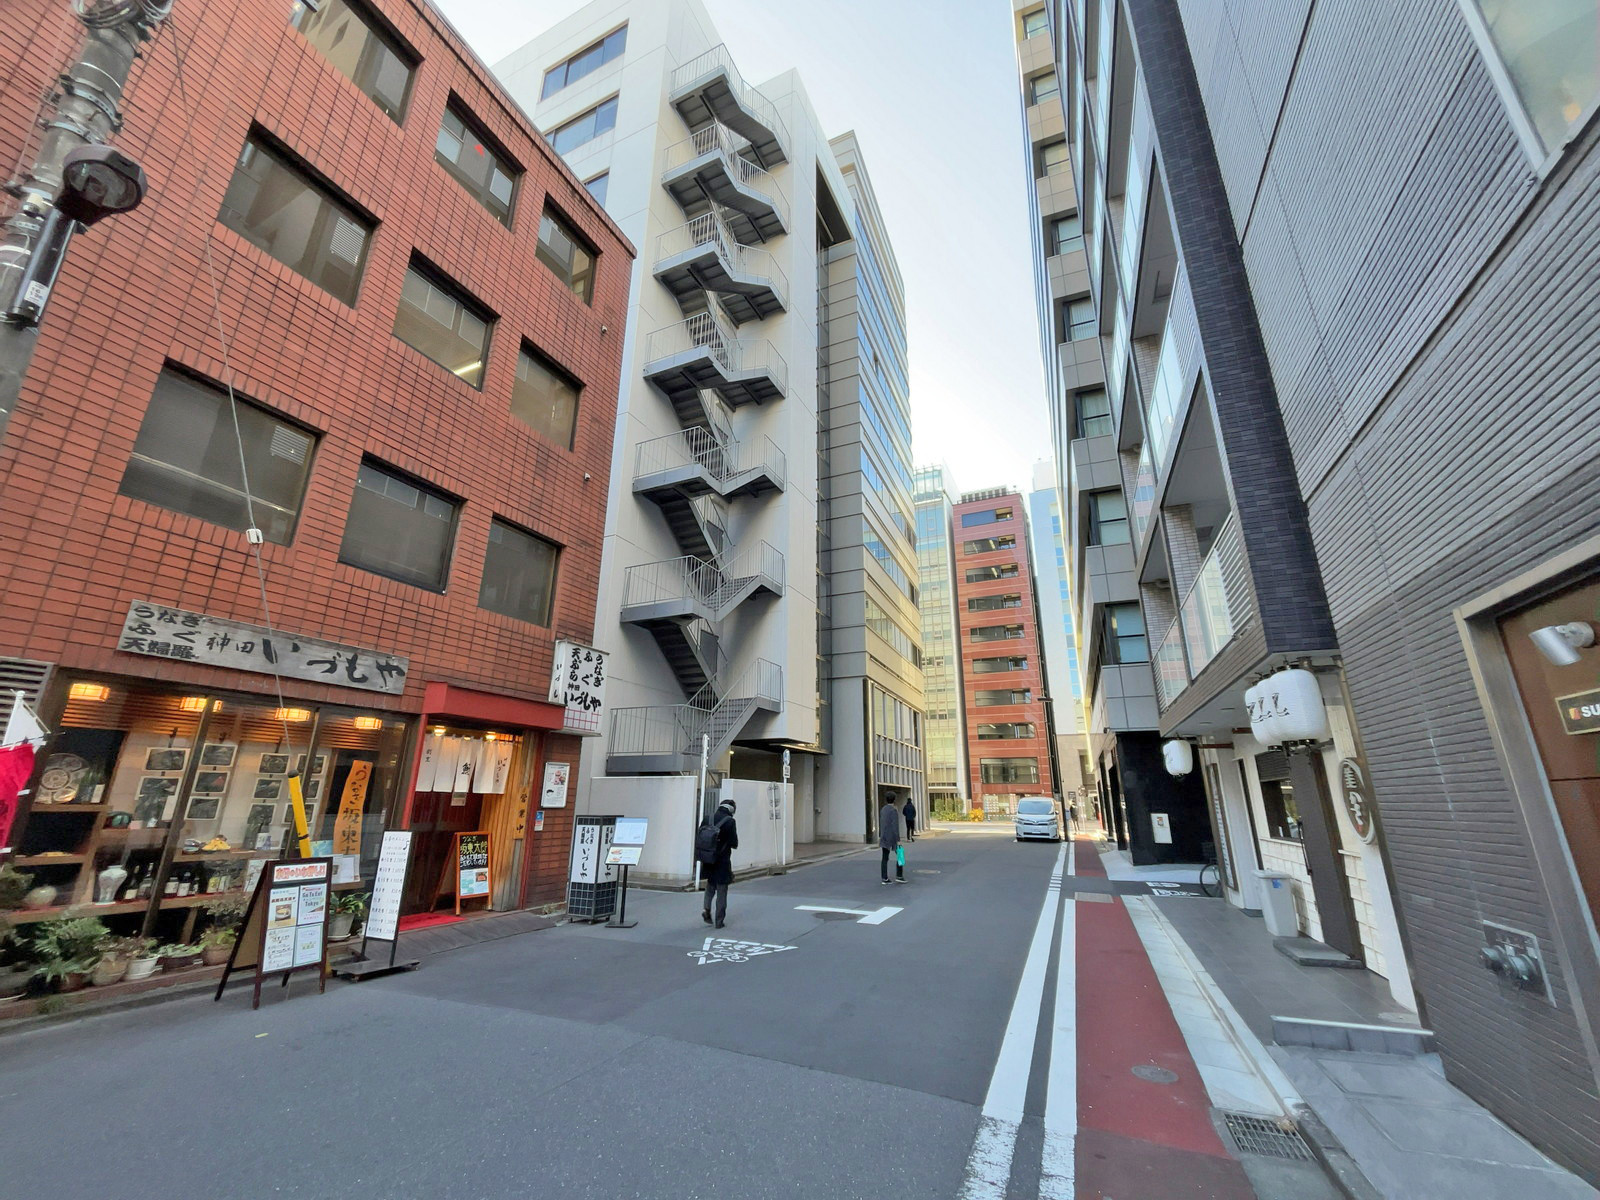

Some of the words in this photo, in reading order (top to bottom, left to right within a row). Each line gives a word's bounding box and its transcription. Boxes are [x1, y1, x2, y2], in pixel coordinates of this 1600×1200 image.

[128, 622, 201, 643] ふぐ
[134, 606, 200, 628] うなぎ
[570, 648, 582, 681] 天ぷら
[582, 651, 593, 685] ふぐ
[594, 654, 604, 687] うなぎ
